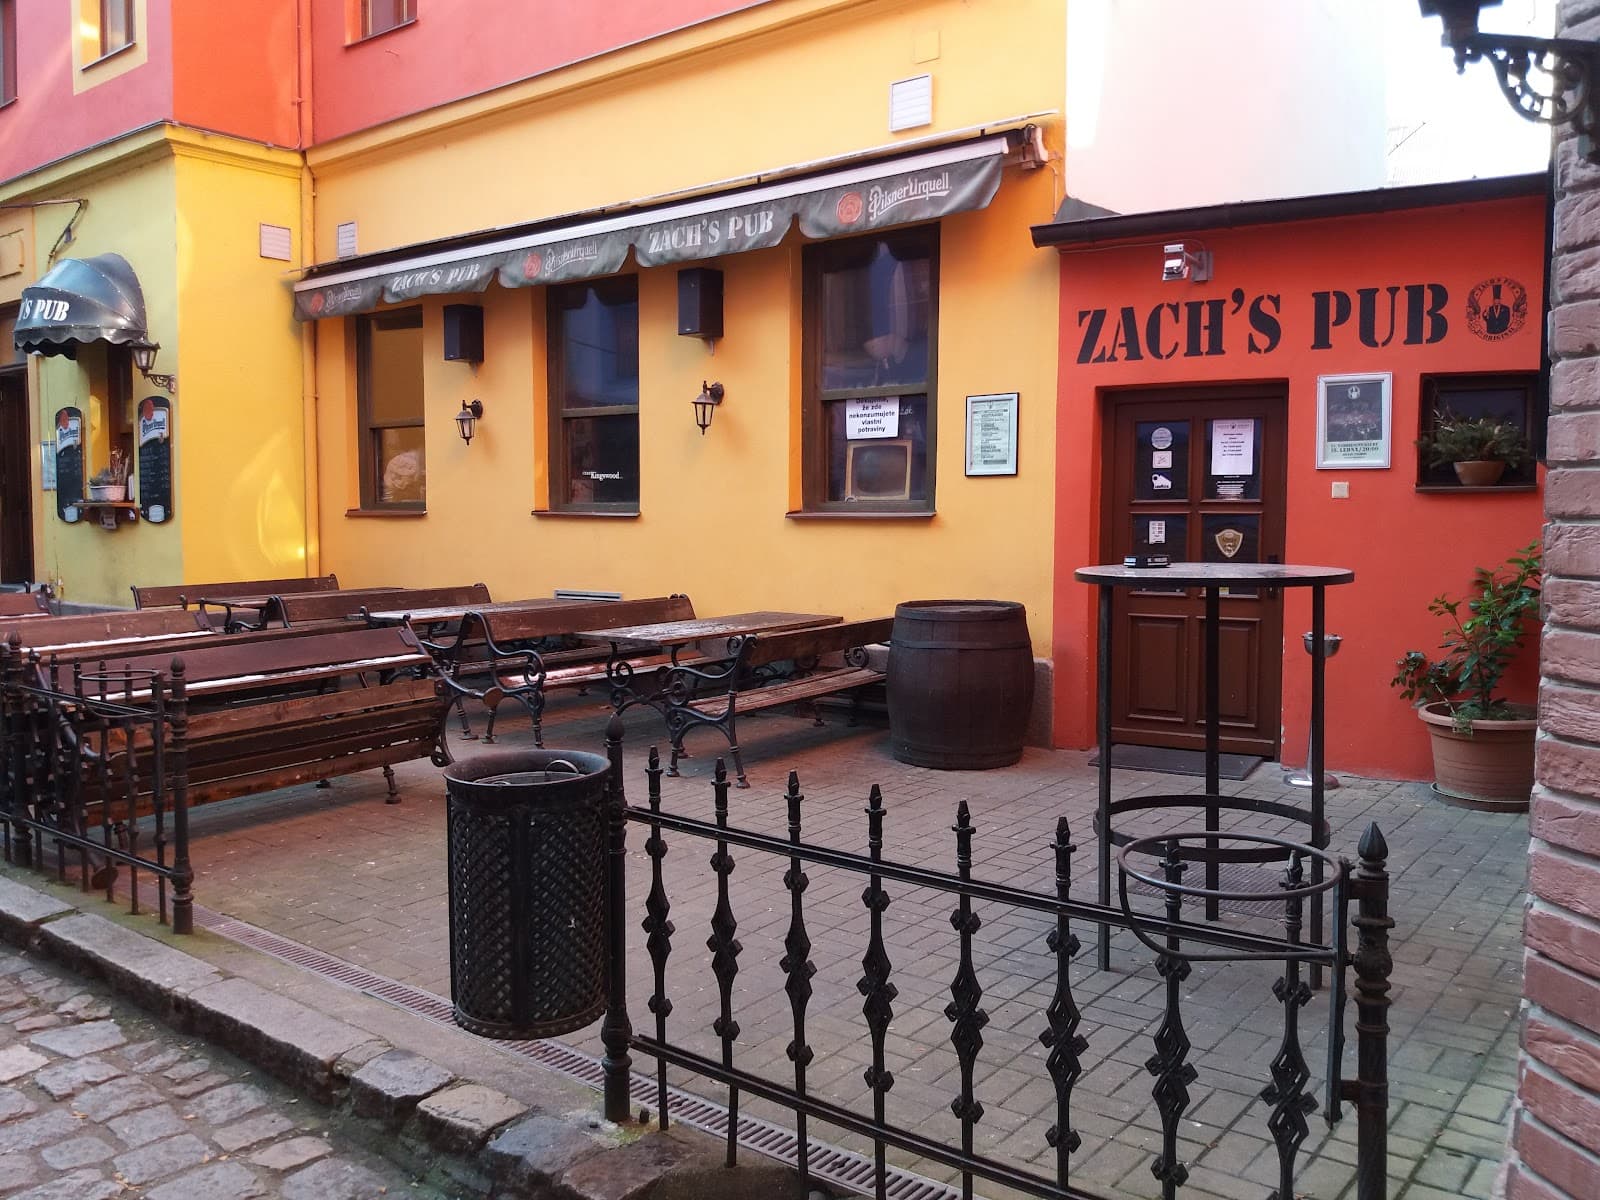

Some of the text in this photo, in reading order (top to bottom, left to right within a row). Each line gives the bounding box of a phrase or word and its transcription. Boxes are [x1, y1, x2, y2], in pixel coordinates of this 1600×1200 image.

[868, 172, 950, 220] Pilsner Urquell
[649, 211, 774, 254] ZACH'S PUB
[392, 264, 480, 293] ZACH'S PUB
[32, 299, 70, 321] PUB
[1077, 284, 1449, 364] ZACH'S PUB
[849, 411, 895, 419] nekonzumujete
[858, 426, 886, 434] potraviny
